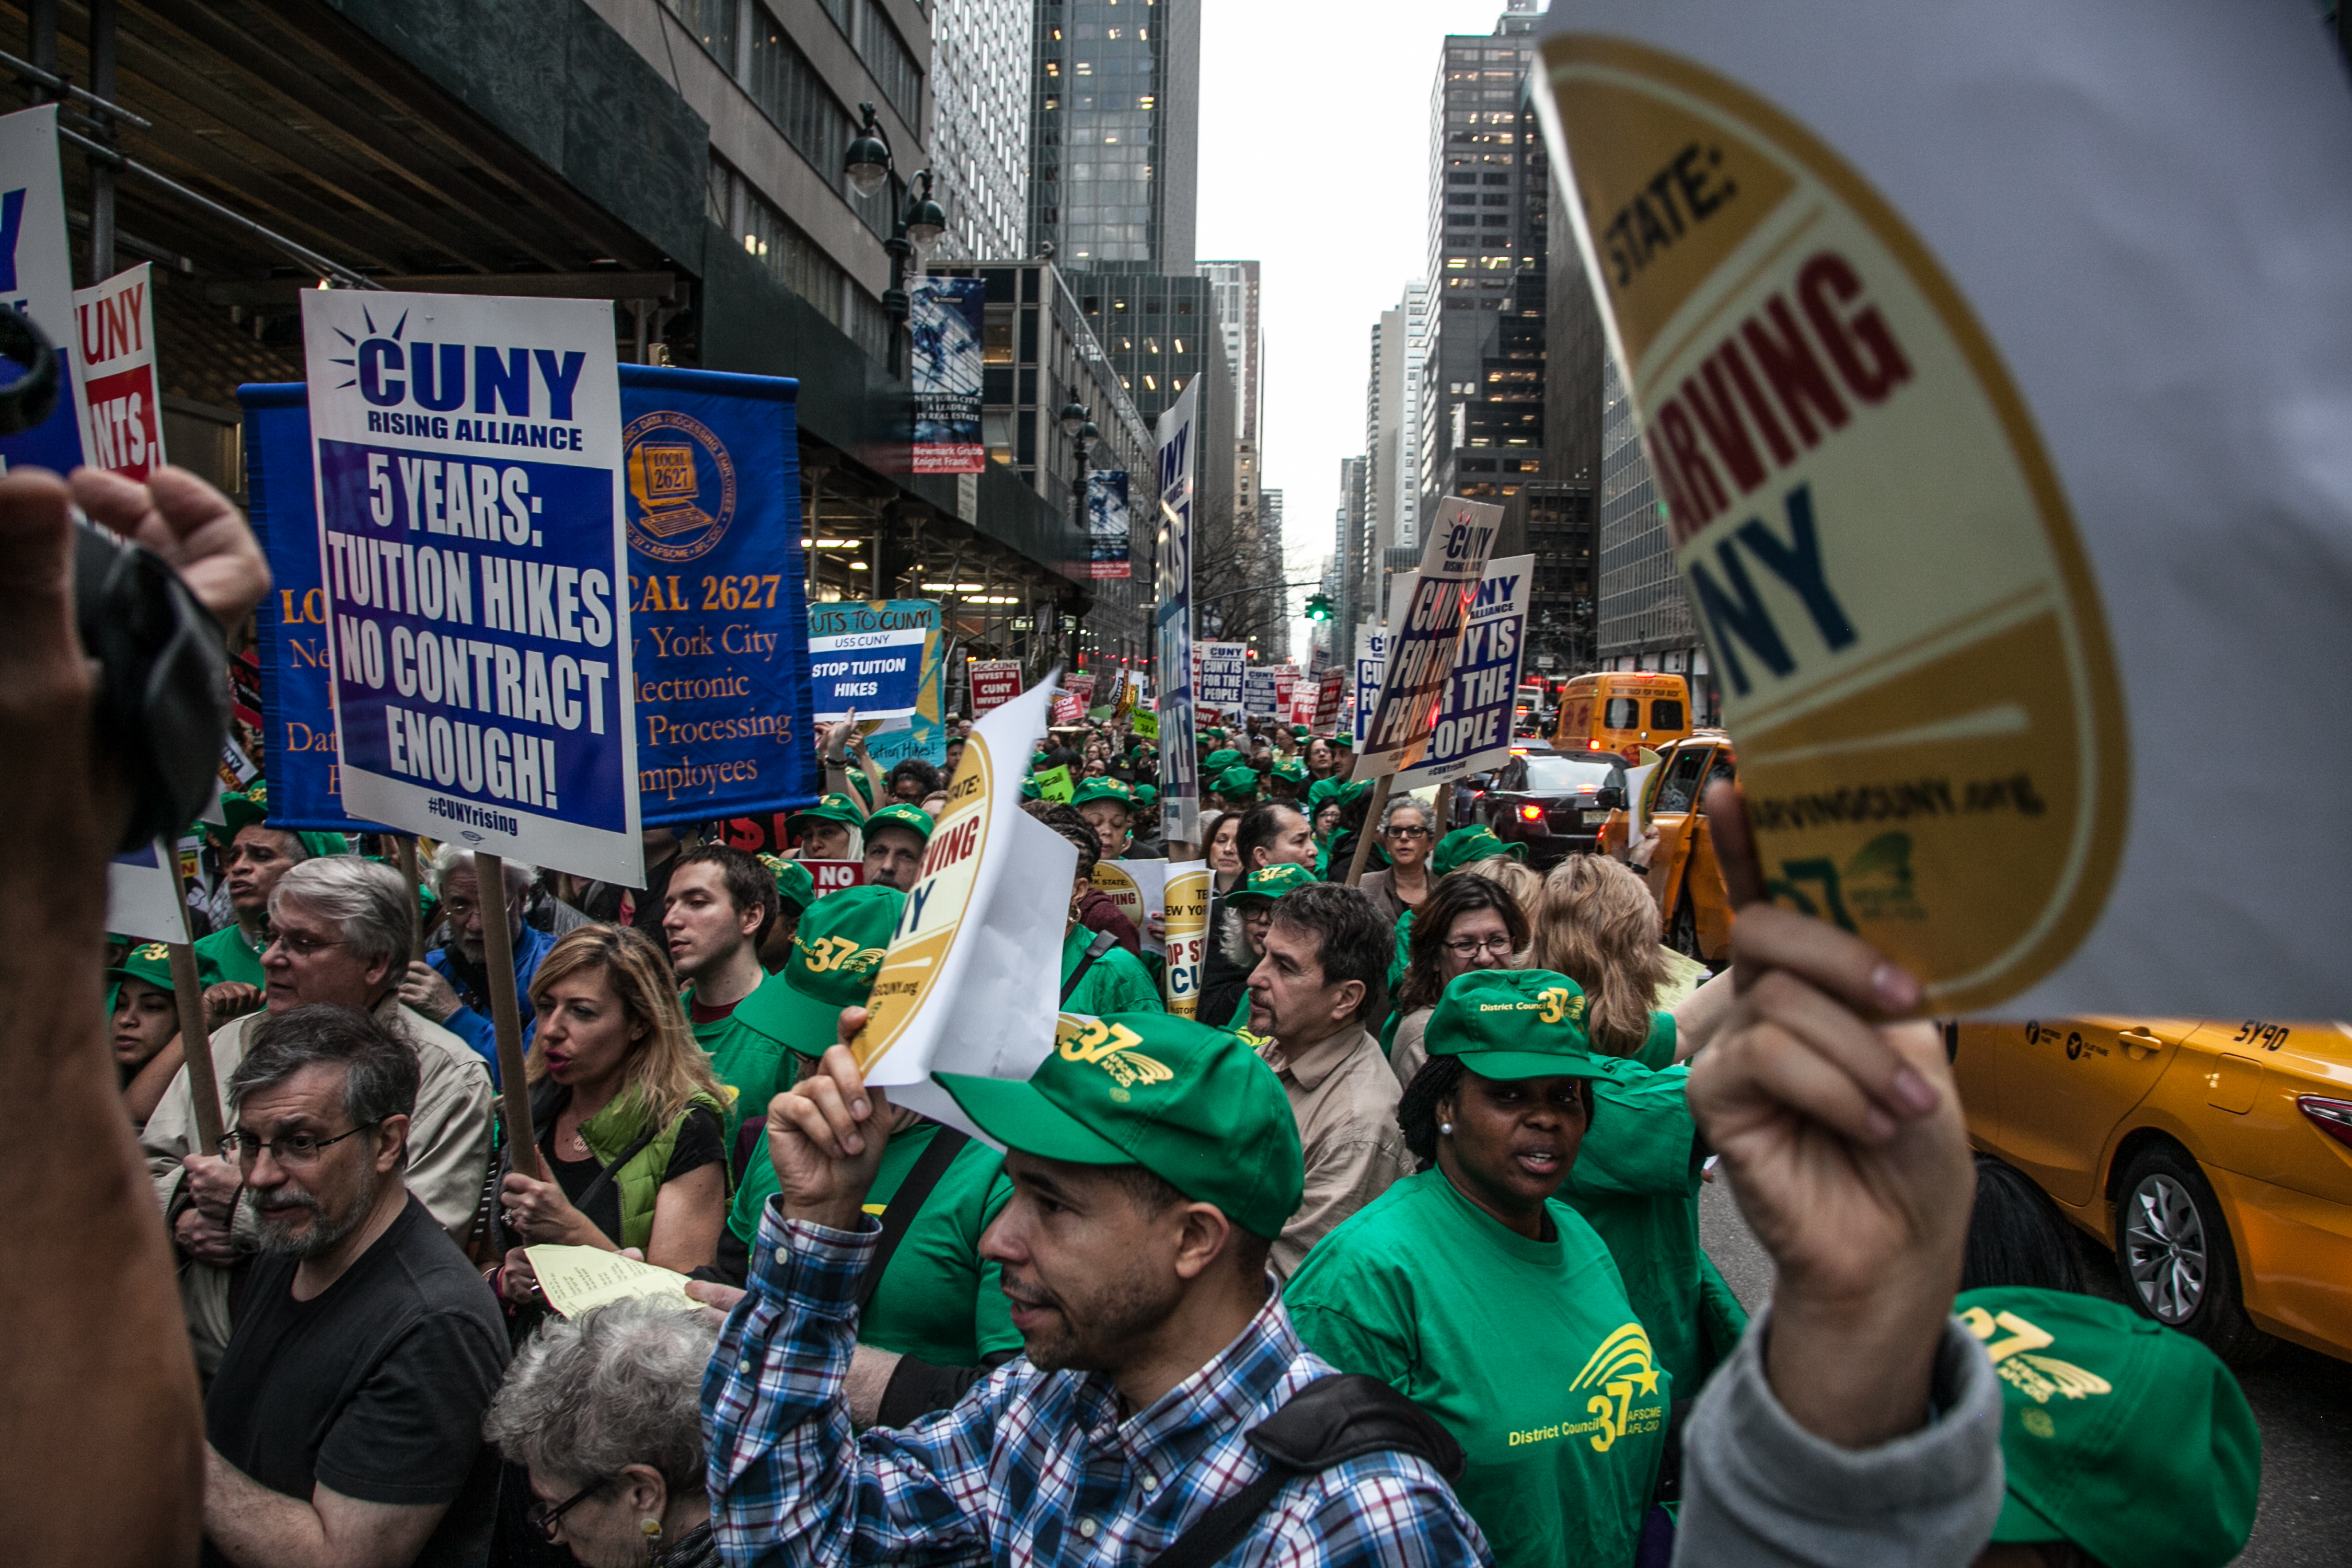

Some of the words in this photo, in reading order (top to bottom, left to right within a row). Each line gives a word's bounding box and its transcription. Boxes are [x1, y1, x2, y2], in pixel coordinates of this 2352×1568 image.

[75, 282, 144, 365] UNY
[359, 338, 586, 421] CUNY
[951, 412, 980, 421] ESTATE
[367, 410, 448, 440] RISING
[455, 419, 583, 452] ALLIANCE
[654, 453, 685, 467] LOCAL
[914, 446, 955, 455] Newmark
[956, 446, 984, 455] Grubb
[914, 456, 942, 468] Knight
[944, 456, 969, 466] Frank
[654, 468, 688, 489] 2627
[367, 453, 394, 527] 5
[398, 456, 542, 547] YEARS:
[328, 530, 473, 626] TUITION
[480, 555, 612, 647] HIKES
[701, 574, 782, 610] 2627
[1475, 575, 1520, 608] NY
[1688, 480, 1858, 698] NY
[811, 612, 847, 633] UTS
[851, 610, 877, 631] TO
[1470, 603, 1514, 620] ALLIANCE
[648, 625, 714, 658] York
[721, 624, 778, 661] City
[835, 637, 856, 648] USS
[858, 635, 890, 647] CUNY
[1488, 618, 1515, 662] IS
[338, 614, 385, 689] NO
[391, 626, 609, 735] CONTRACT
[812, 662, 849, 677] STOP
[851, 658, 906, 675] TUITION
[974, 672, 1004, 680] INVEST
[1204, 661, 1229, 673] CUNY
[1230, 662, 1241, 673] IS
[1391, 639, 1434, 690] FOR
[1428, 636, 1457, 683] THE
[633, 667, 750, 703] lectronic
[834, 682, 878, 697] HIKES
[981, 683, 1012, 694] CUNY
[1112, 678, 1124, 705] CUNY
[1203, 674, 1220, 686] FOR
[1223, 675, 1241, 687] THE
[1295, 683, 1320, 693] PSC-C
[1462, 663, 1512, 710] THE
[1054, 697, 1075, 710] STOP
[1204, 688, 1239, 701] PEOPLE
[646, 708, 793, 746] Processing
[1196, 711, 1214, 722] UNY
[1426, 709, 1501, 762] EOPLE
[386, 705, 558, 810] ENOUGH!
[639, 756, 758, 801] mployees
[1039, 771, 1064, 788] ocal
[429, 797, 518, 836] #CUNYrising
[819, 866, 854, 886] NO
[1259, 867, 1282, 882] 37
[1166, 905, 1183, 916] EW
[805, 936, 860, 972] 37
[841, 964, 867, 973] AFL-CIO
[1480, 1002, 1513, 1012] District
[1537, 987, 1569, 1024] 37
[1060, 1020, 1144, 1064] 37
[1100, 1060, 1132, 1088] AFL-CIO
[1106, 1053, 1138, 1081] AFSCME
[1509, 1425, 1559, 1446] District
[1562, 1417, 1600, 1436] Council
[1587, 1380, 1633, 1452] 37
[1627, 1406, 1662, 1421] AFSCME
[1627, 1420, 1659, 1435] AFL-CIO
